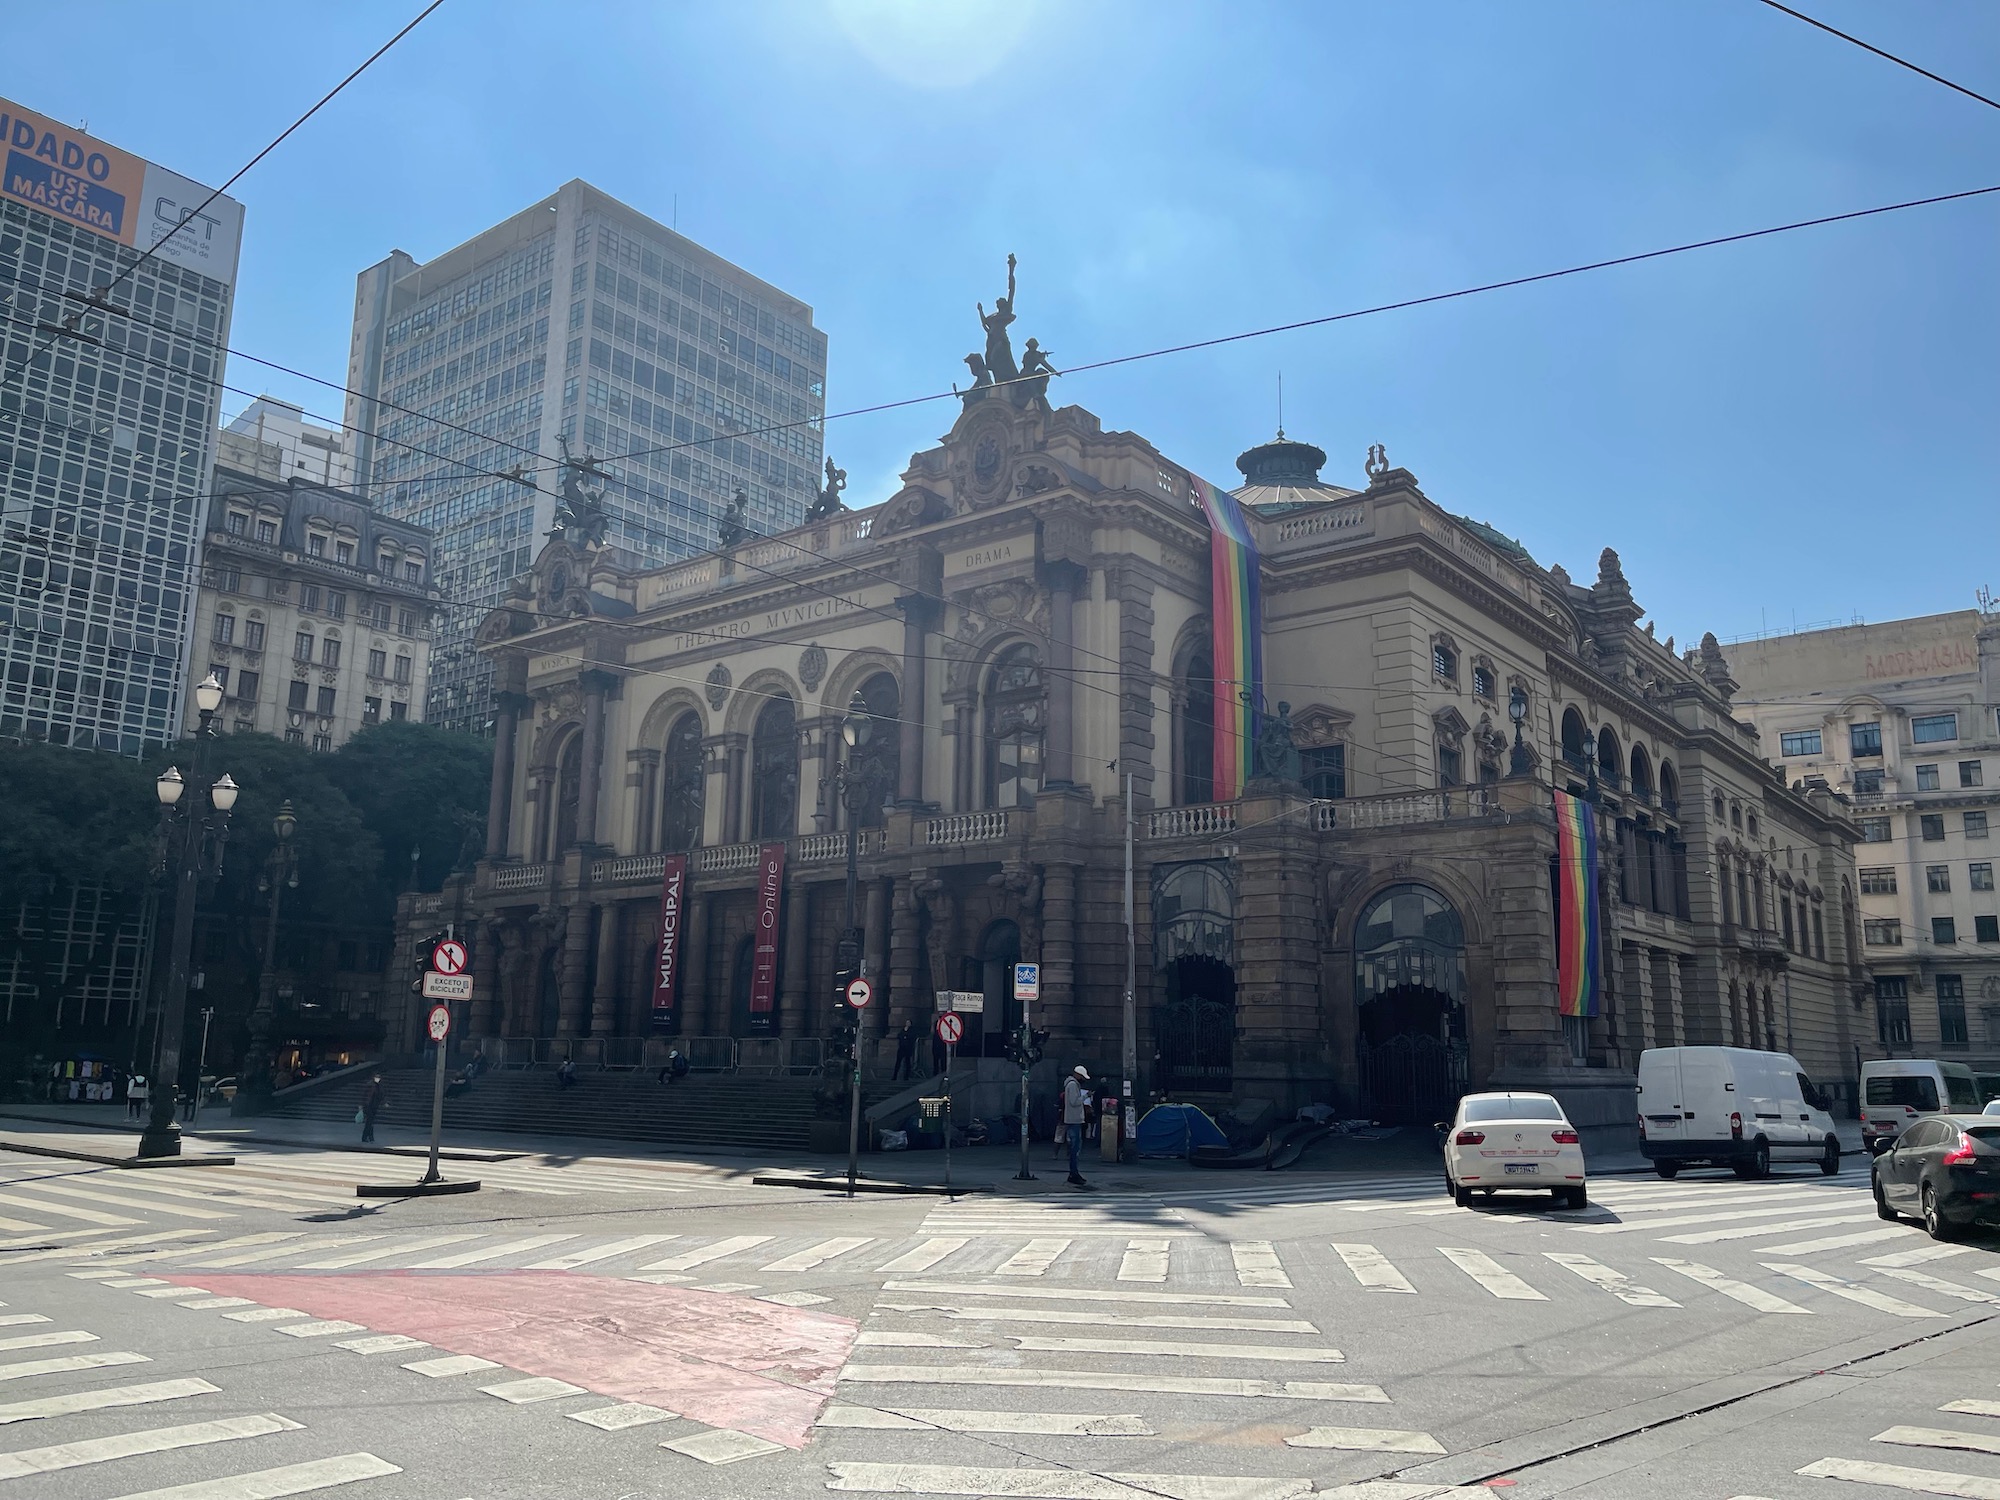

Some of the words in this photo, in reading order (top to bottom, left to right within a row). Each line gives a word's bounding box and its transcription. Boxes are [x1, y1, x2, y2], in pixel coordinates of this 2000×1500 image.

[50, 170, 89, 201] USE
[12, 174, 114, 230] MÁSCARA
[154, 196, 222, 241] CET
[150, 238, 181, 256] Tfego
[151, 230, 197, 254] Enenharia
[198, 250, 209, 259] de
[152, 222, 198, 246] Comanhia
[199, 242, 210, 251] de
[965, 546, 1012, 568] DRAMA
[674, 620, 751, 651] THEATRO
[765, 592, 869, 630] MVNICIPAL
[761, 861, 778, 929] Online
[659, 870, 681, 989] MUNICIPAL
[430, 985, 464, 993] BICICLETA
[435, 978, 462, 986] EXCETO
[967, 993, 983, 1002] Ramos
